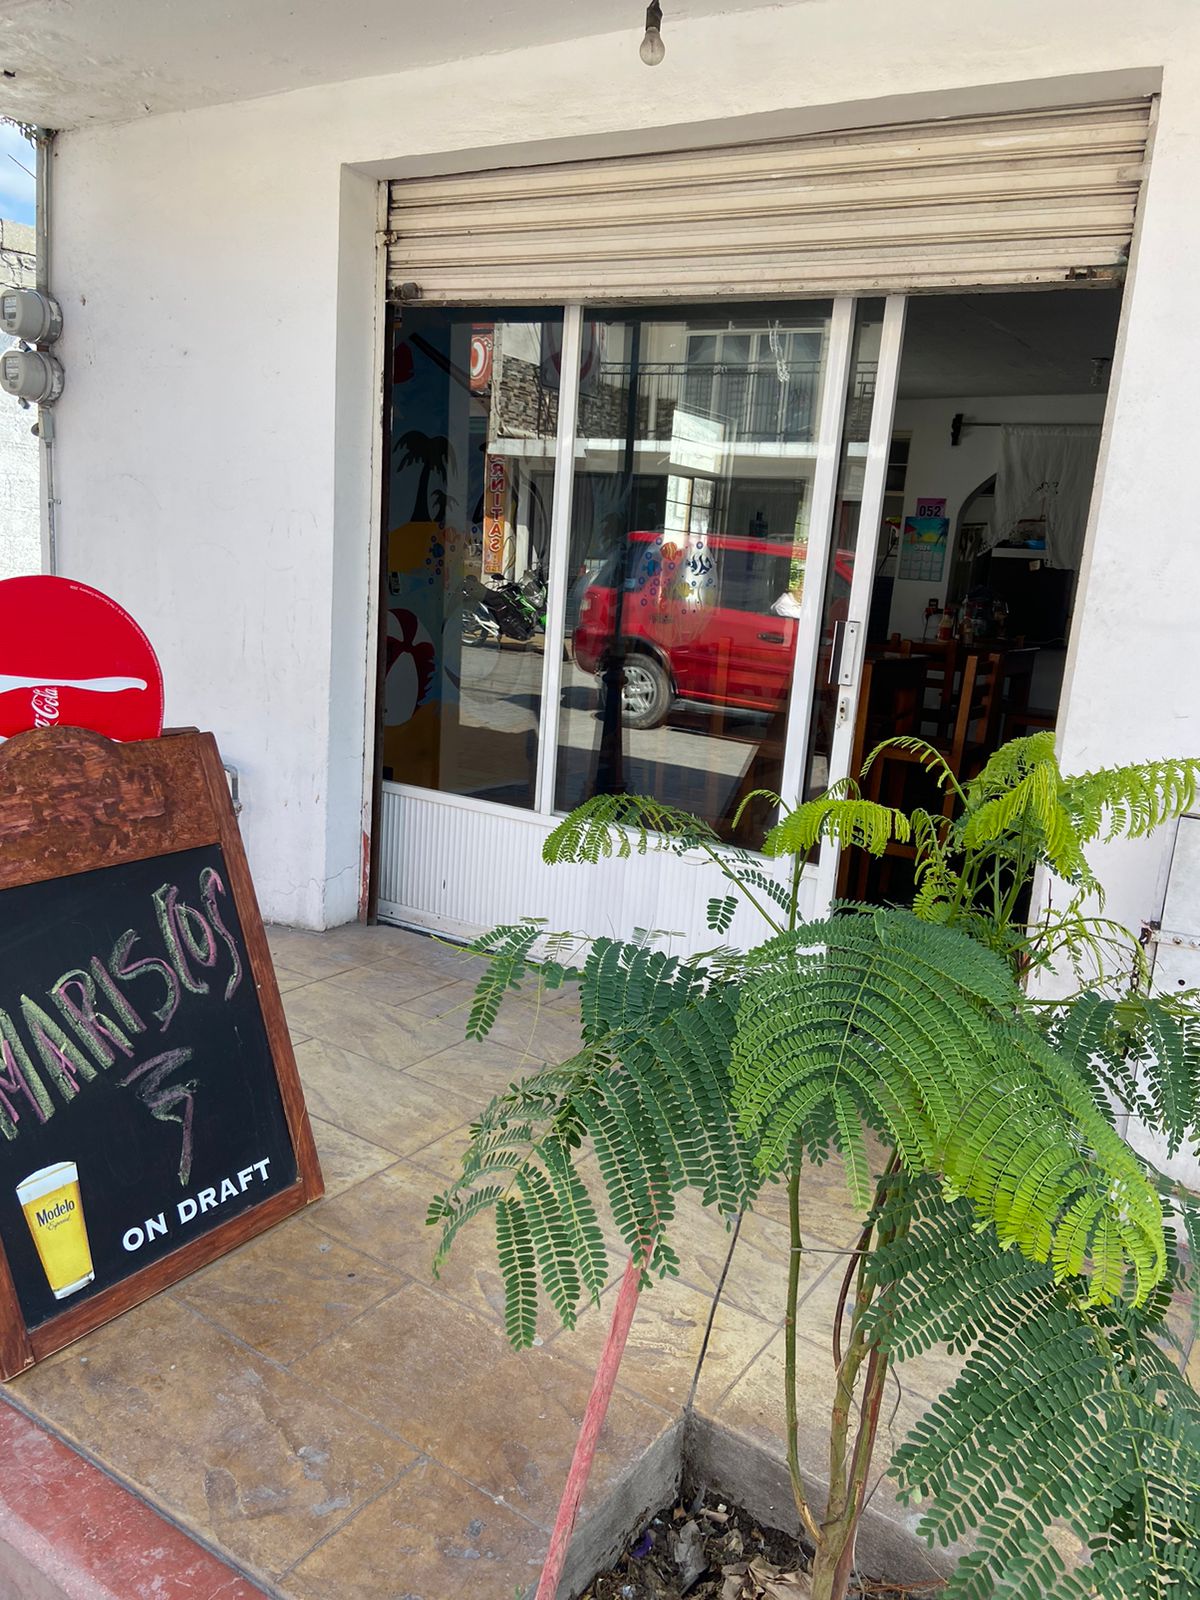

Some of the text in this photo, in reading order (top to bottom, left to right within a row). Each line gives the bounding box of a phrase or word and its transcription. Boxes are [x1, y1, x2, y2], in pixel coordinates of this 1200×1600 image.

[919, 505, 941, 517] 052
[36, 1199, 75, 1227] Modelo
[122, 1157, 271, 1252] ON DRAFT
